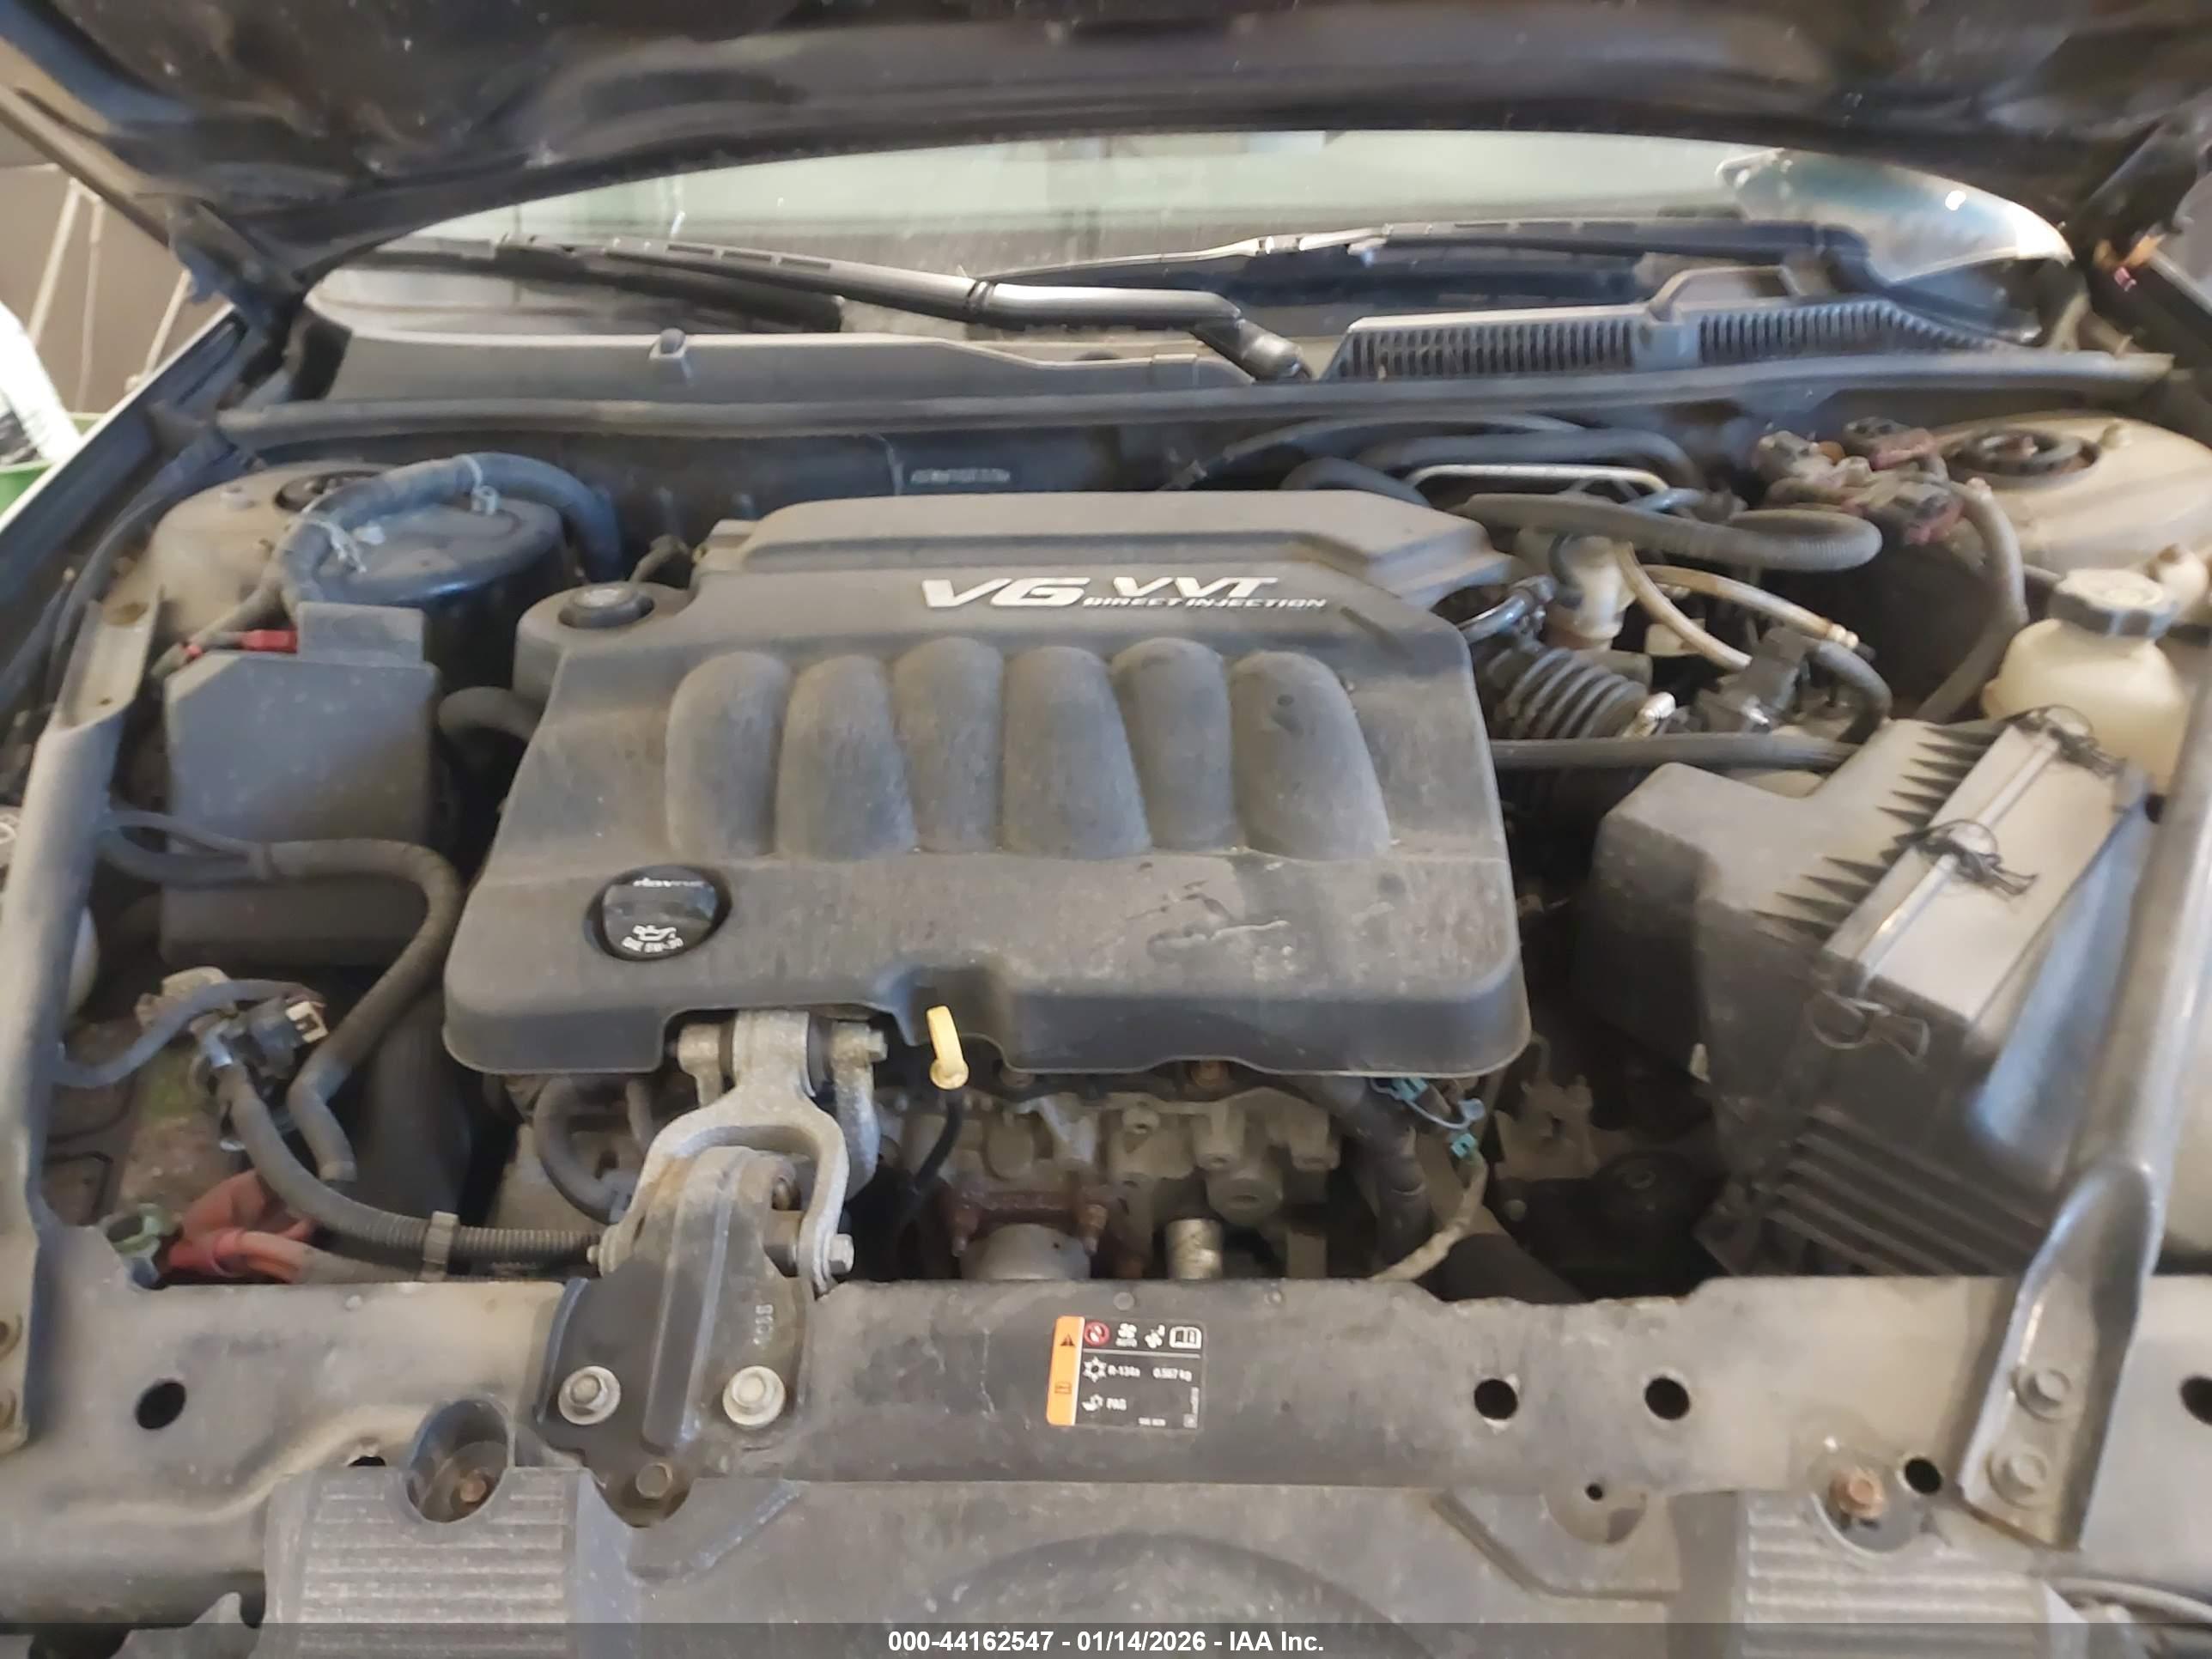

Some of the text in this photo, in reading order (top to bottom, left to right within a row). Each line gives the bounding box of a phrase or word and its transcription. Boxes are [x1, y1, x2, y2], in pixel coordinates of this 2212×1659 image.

[921, 576, 1278, 608] V6 VVT
[1082, 597, 1328, 609] DIRECT INJECTION
